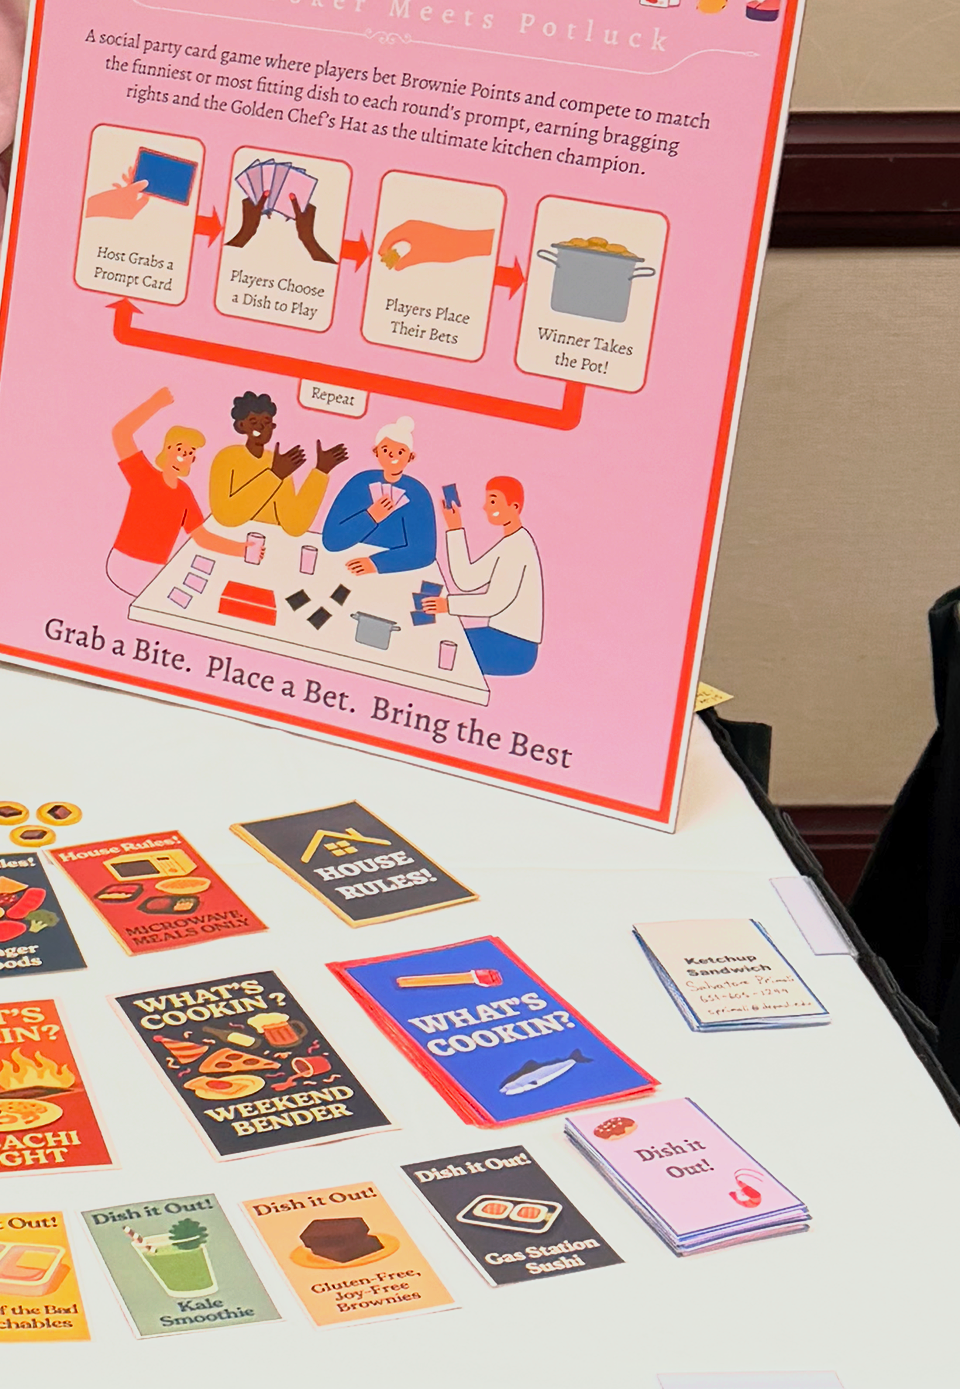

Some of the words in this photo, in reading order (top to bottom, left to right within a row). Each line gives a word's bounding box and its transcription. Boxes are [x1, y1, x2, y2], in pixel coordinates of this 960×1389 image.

[519, 12, 668, 51] Potluck
[85, 29, 96, 43] A
[99, 31, 140, 49] social
[143, 38, 182, 58] party
[184, 44, 217, 60] card
[220, 50, 261, 67] game
[265, 53, 311, 73] where
[314, 60, 368, 82] players
[373, 68, 397, 85] bet
[401, 73, 467, 95] Brownie
[470, 82, 521, 104] Points
[524, 91, 555, 108] and
[559, 96, 631, 119] compete
[634, 106, 652, 121] to
[655, 109, 711, 130] match
[105, 56, 129, 73] the
[132, 59, 192, 82] funniest
[196, 72, 212, 85] or
[215, 74, 253, 91] most
[256, 76, 303, 101] fitting
[307, 82, 339, 103] dish
[343, 92, 360, 106] to
[363, 94, 398, 112] each
[402, 100, 461, 121] round's
[465, 110, 531, 133] prompt,
[534, 121, 599, 145] earning
[603, 128, 680, 157] bragging
[97, 246, 126, 262] Host
[129, 251, 165, 269] Grabs
[167, 261, 174, 270] a
[93, 267, 140, 286] Prompt
[142, 275, 173, 291] Card
[230, 270, 274, 289] Players
[278, 278, 325, 298] Choose
[232, 294, 239, 303] a
[242, 294, 271, 310] Dish
[274, 300, 288, 312] to
[290, 303, 318, 320] Play
[385, 298, 432, 318] Players
[435, 307, 470, 325] Place
[391, 321, 426, 339] Their
[429, 329, 458, 345] Bets
[537, 327, 590, 349] Winner
[593, 337, 633, 356] Takes
[554, 352, 577, 369] the
[580, 358, 609, 375] Pot!
[311, 387, 355, 406] Repeat
[45, 618, 106, 651] Grab
[112, 639, 126, 656] a
[133, 638, 191, 672] Bite.
[206, 655, 274, 692] Place
[281, 680, 296, 698] a
[302, 678, 355, 713] Bet.
[371, 695, 450, 744] Bring
[457, 718, 502, 750] the
[508, 731, 573, 768] Best
[314, 850, 415, 882] HOUSE
[335, 868, 438, 901] RULES!
[124, 910, 243, 938] MICROWAVE
[131, 927, 199, 947] MEALS
[199, 917, 252, 936] ONLY
[683, 954, 757, 965] Ketchup
[686, 964, 772, 977] Sandwich
[407, 992, 547, 1035] WHAT'S
[426, 1010, 576, 1057] COOKIN?
[203, 1086, 355, 1123] WEEKEND
[230, 1103, 354, 1137] BENDER
[634, 1141, 686, 1162] Dish
[683, 1139, 707, 1152] it
[665, 1158, 715, 1179] Out!
[484, 1249, 526, 1267] Gas
[525, 1236, 601, 1261] Station
[525, 1257, 586, 1276] Sushi
[310, 1269, 422, 1295] Gluten-Free,
[334, 1281, 411, 1303] Joy-Free
[177, 1297, 224, 1313] Kale
[336, 1290, 422, 1313] Brownies
[159, 1306, 256, 1328] Smoothie
